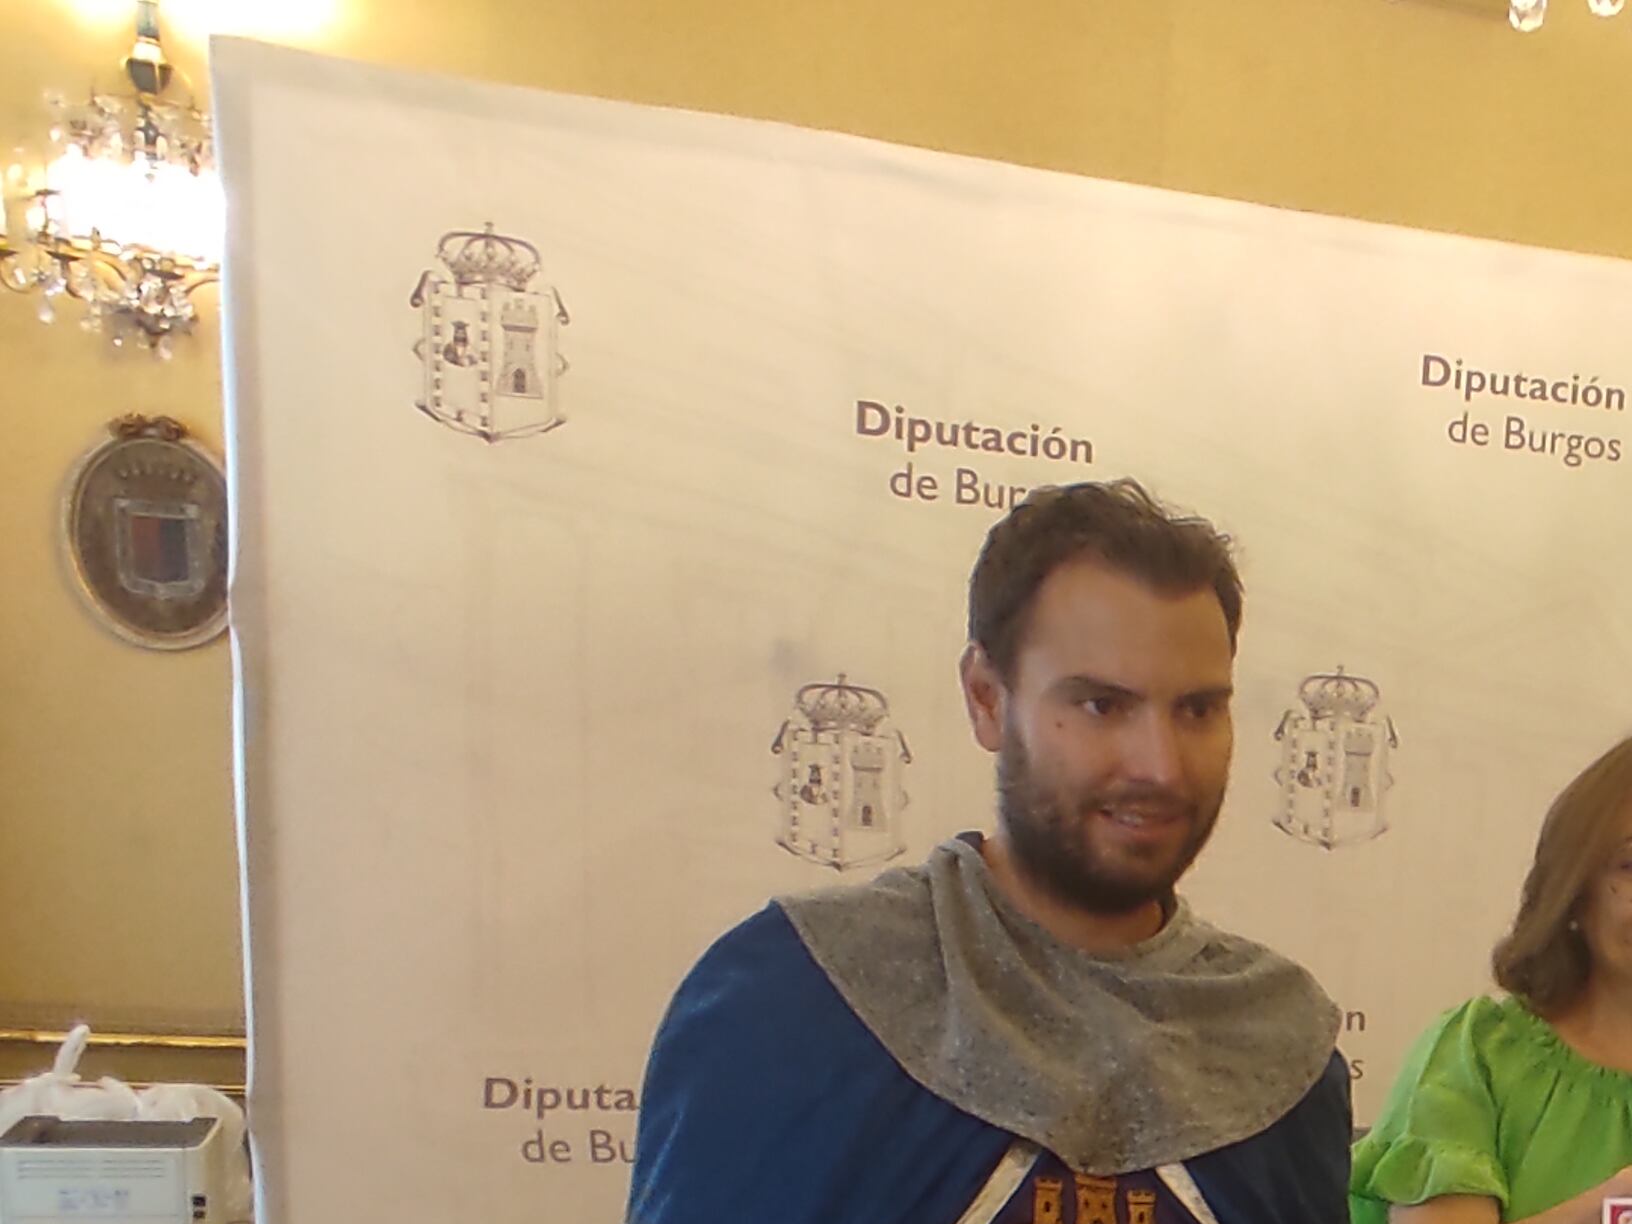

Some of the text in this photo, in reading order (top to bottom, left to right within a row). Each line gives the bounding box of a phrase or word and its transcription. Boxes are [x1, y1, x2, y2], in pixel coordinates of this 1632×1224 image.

[1421, 354, 1625, 411] Diputación
[856, 400, 1093, 464] Diputación
[1448, 411, 1622, 468] de Burgos
[889, 461, 1027, 509] de Bur
[483, 1076, 639, 1120] Diputa
[521, 1128, 571, 1164] de
